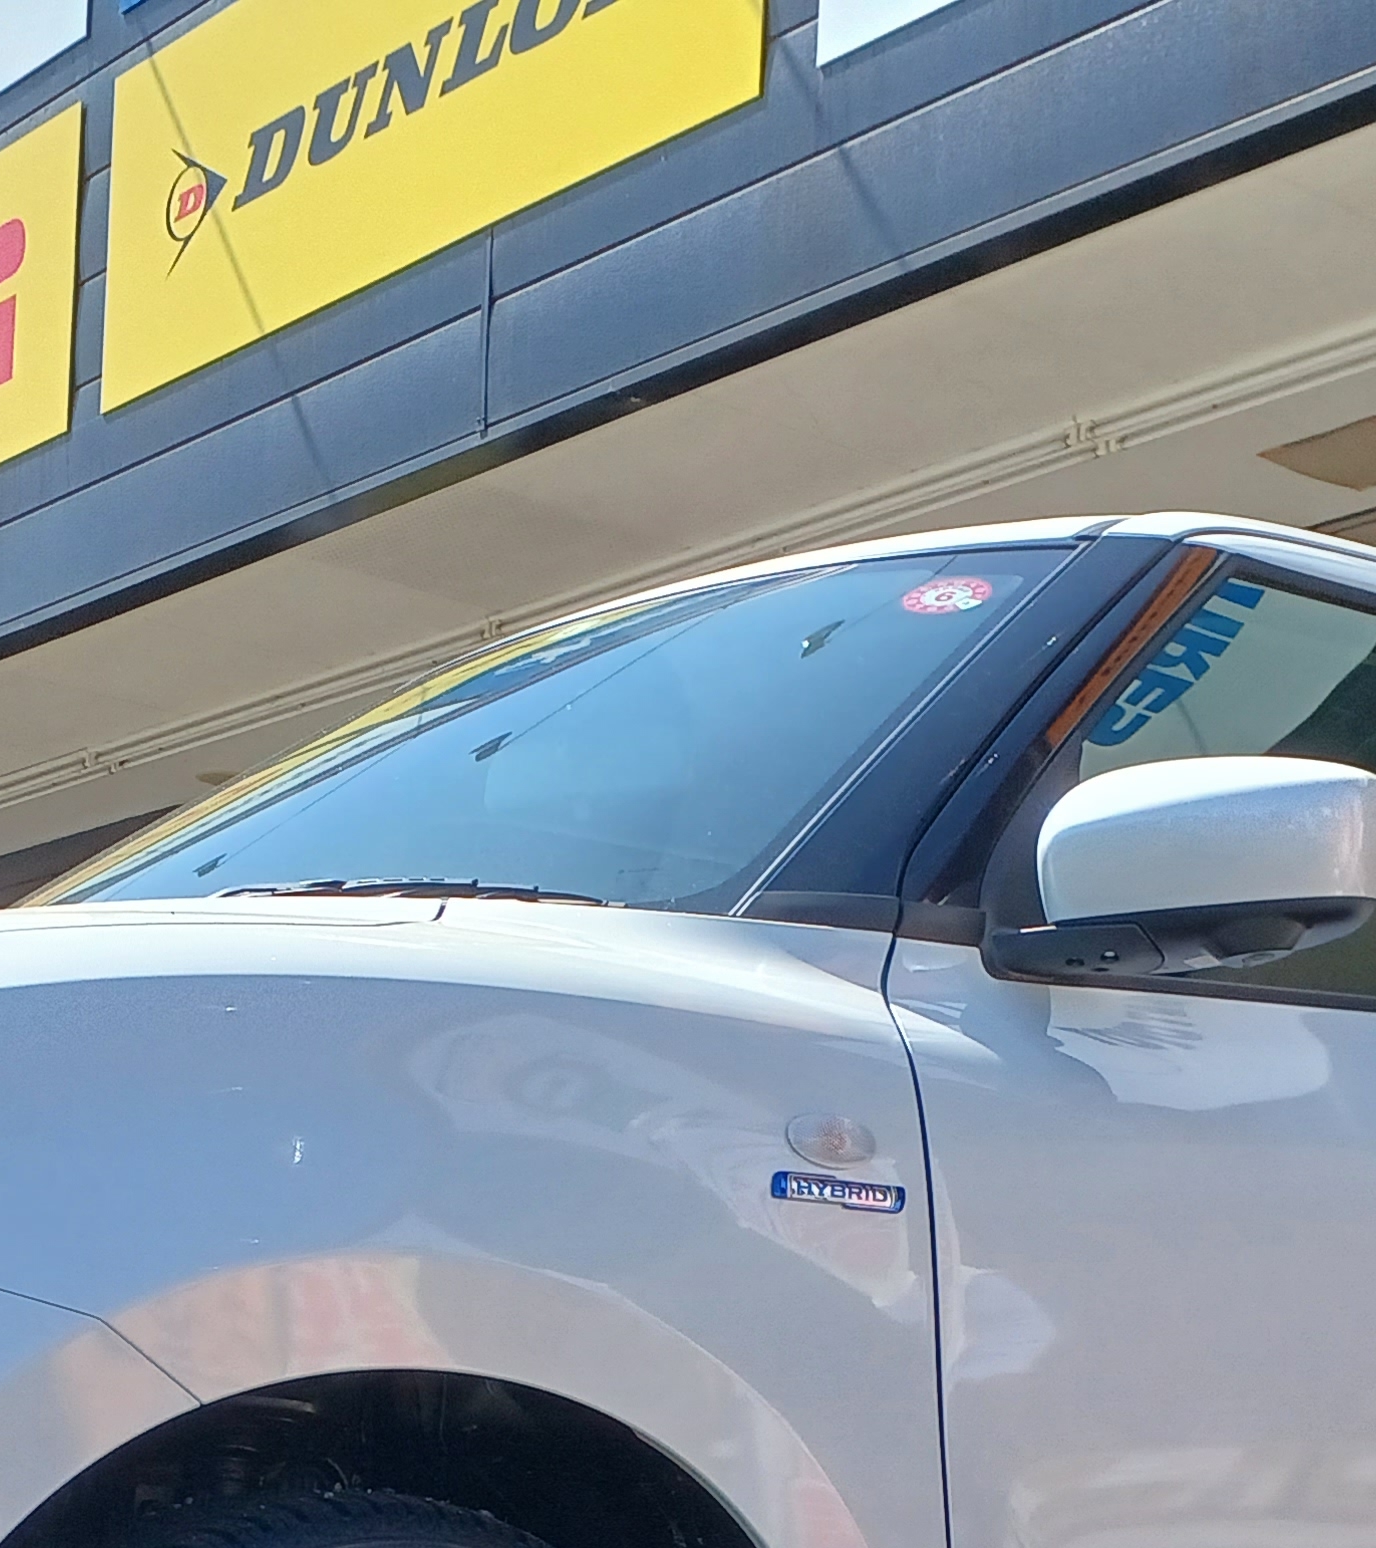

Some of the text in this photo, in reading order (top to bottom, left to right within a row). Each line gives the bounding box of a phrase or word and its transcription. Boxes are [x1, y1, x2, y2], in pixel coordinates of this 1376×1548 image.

[232, 0, 622, 212] DUNLO
[172, 183, 205, 223] D
[795, 1177, 889, 1203] HYBRID
